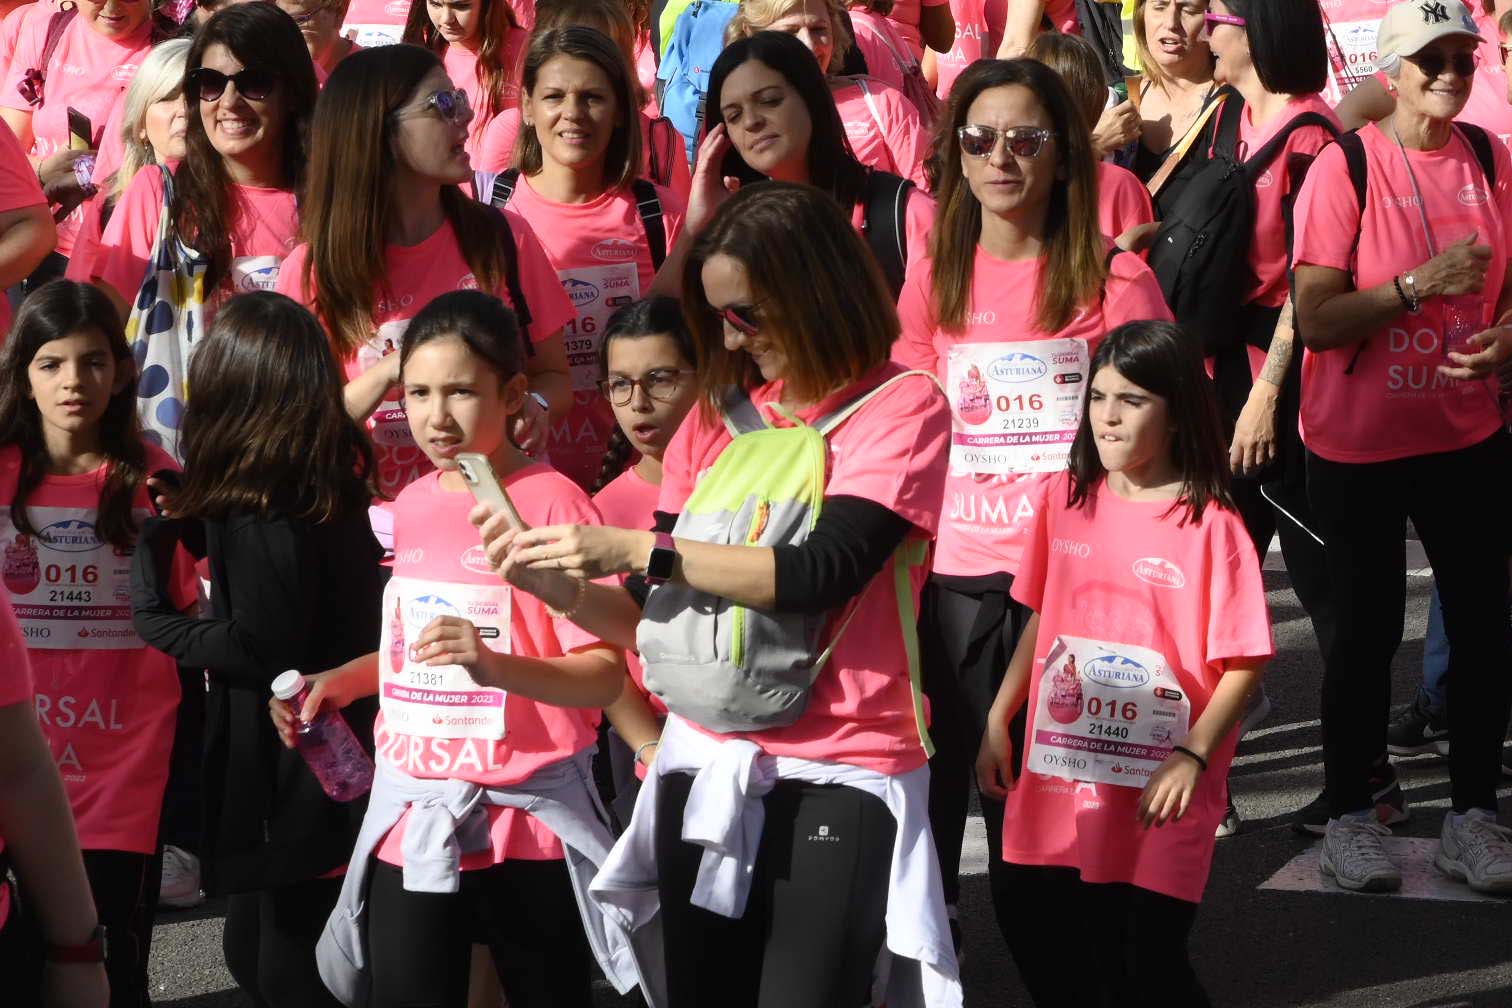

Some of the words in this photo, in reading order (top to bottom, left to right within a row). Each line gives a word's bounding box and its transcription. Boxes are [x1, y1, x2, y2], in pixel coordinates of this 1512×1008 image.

[1349, 51, 1378, 65] 016
[1053, 356, 1080, 365] SUMA
[990, 364, 1044, 377] ASTURIANA
[996, 393, 1044, 412] 016
[1002, 417, 1039, 430] 21239
[967, 434, 1006, 444] CARRERA
[1007, 434, 1018, 443] DE
[1019, 434, 1030, 442] LA
[1032, 432, 1060, 442] MUJER
[964, 453, 1007, 465] OYSHO
[1051, 538, 1090, 559] OYSHO
[45, 564, 99, 585] 016
[50, 590, 92, 603] 21443
[51, 608, 66, 617] DE
[67, 608, 80, 617] LA
[81, 608, 112, 617] MUJER
[467, 606, 500, 616] SUMA
[409, 671, 444, 686] 21381
[1088, 664, 1144, 685] ASTURIANA
[410, 690, 422, 700] DE
[423, 692, 433, 701] LA
[435, 693, 467, 703] MUJER
[470, 695, 494, 704] 2023
[33, 694, 124, 730] RSAL
[1087, 696, 1138, 721] 016
[1089, 722, 1129, 739] 21440
[1050, 735, 1088, 748] CARRERA
[1090, 740, 1103, 751] DE
[1104, 743, 1115, 752] LA
[1117, 744, 1148, 757] MUJER
[1043, 752, 1087, 770] OYSHO
